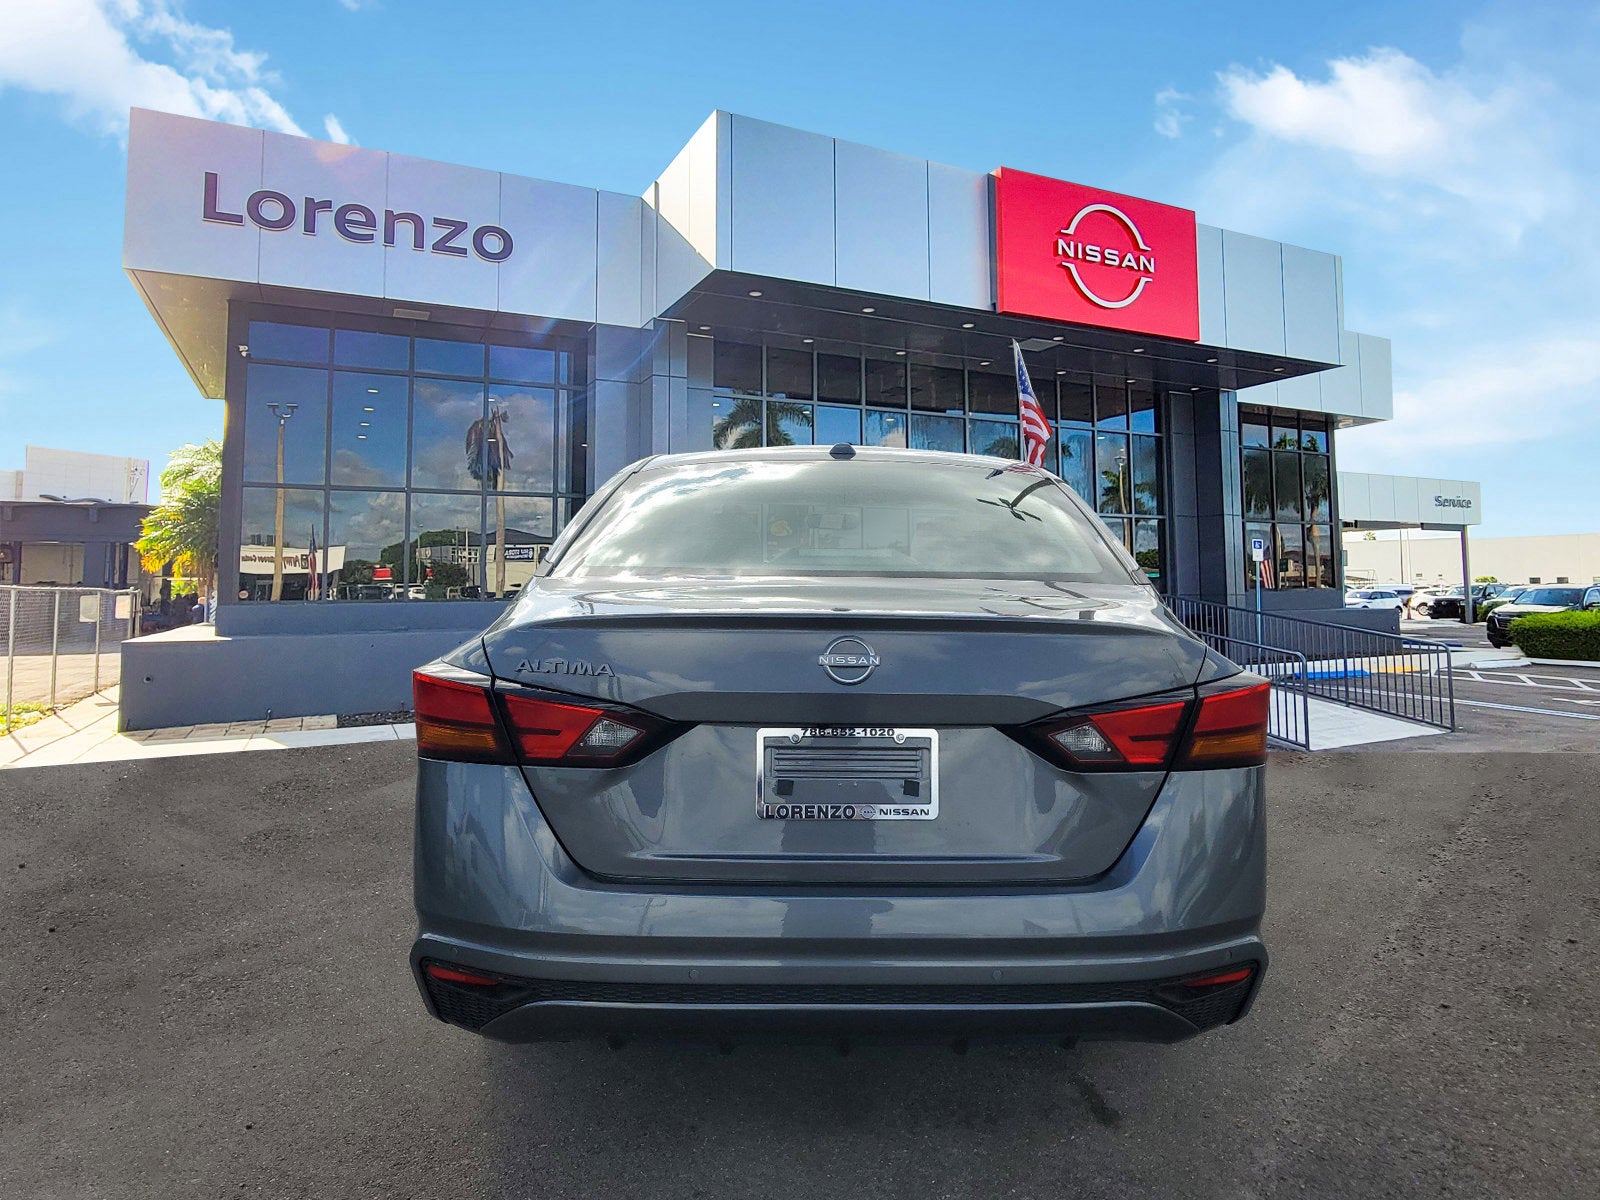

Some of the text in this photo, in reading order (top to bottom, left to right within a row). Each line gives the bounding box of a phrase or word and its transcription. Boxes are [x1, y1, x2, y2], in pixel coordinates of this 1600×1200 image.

[202, 171, 515, 263] Lorenzo
[1057, 238, 1155, 273] NISSAN
[1434, 495, 1472, 509] Service
[515, 659, 616, 677] ALTIMA
[819, 656, 880, 664] NISSAN
[764, 804, 856, 819] LORENZO
[879, 808, 930, 816] NISSAN
